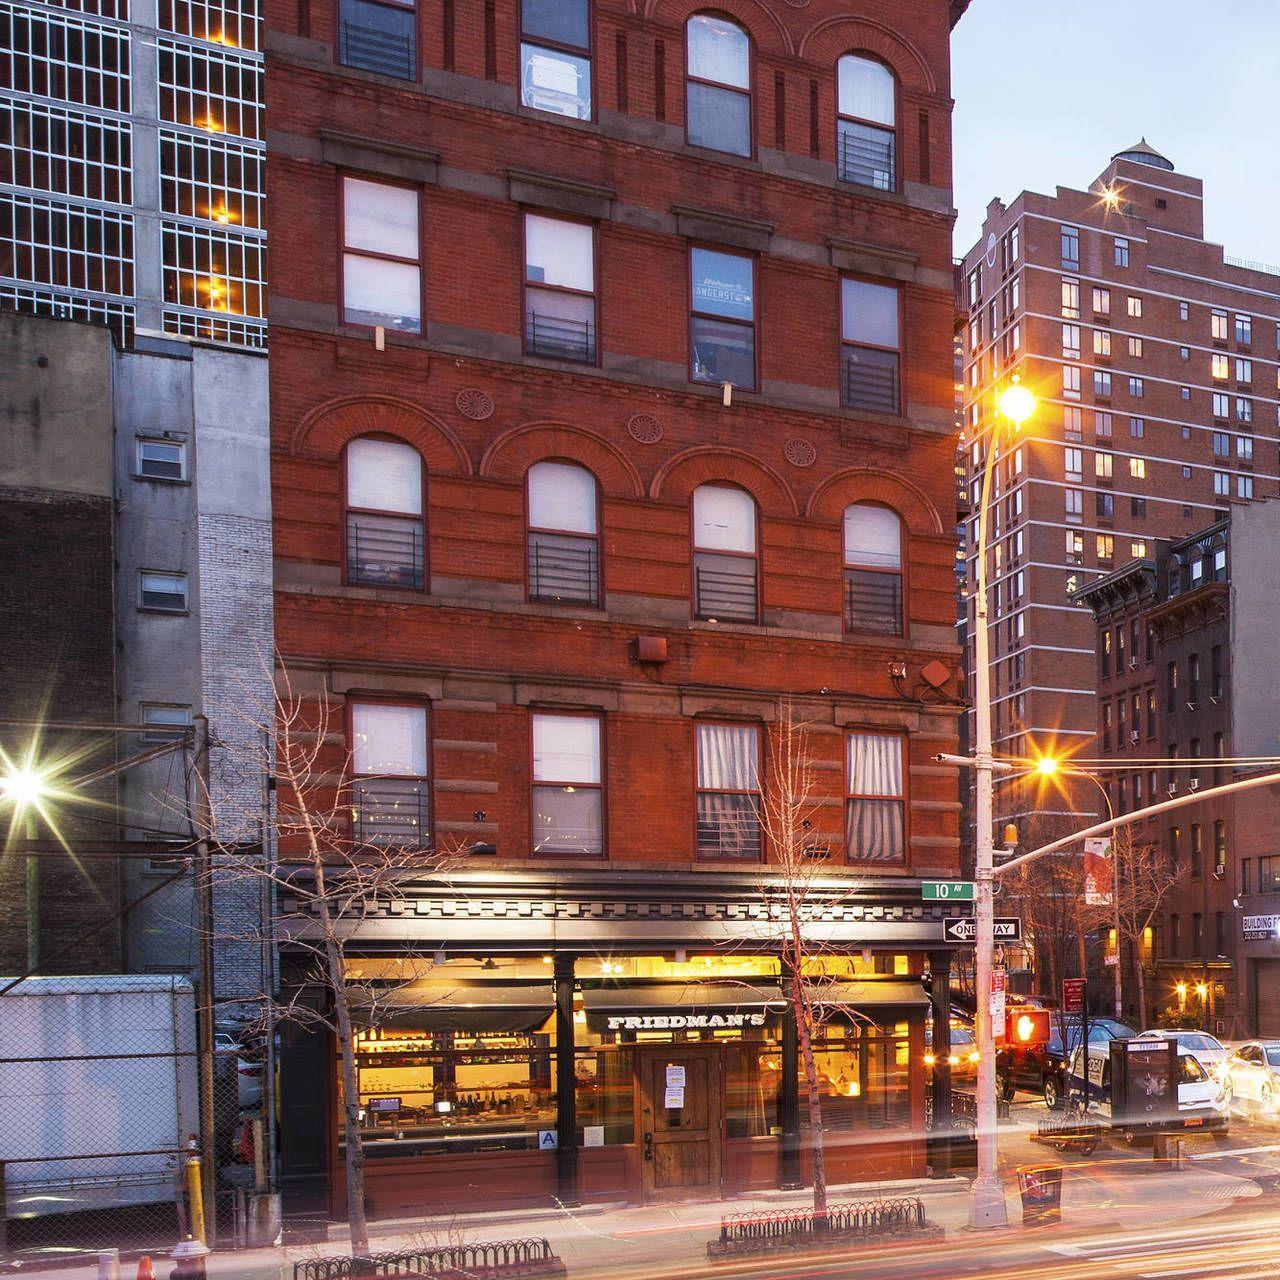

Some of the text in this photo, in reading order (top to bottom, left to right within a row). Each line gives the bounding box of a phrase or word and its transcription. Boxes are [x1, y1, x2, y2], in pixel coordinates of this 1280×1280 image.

[935, 884, 949, 898] 10
[956, 925, 977, 935] ONE
[1244, 917, 1272, 930] BUILDING
[608, 1014, 764, 1029] FRIEDMAN'S
[542, 1131, 555, 1145] A
